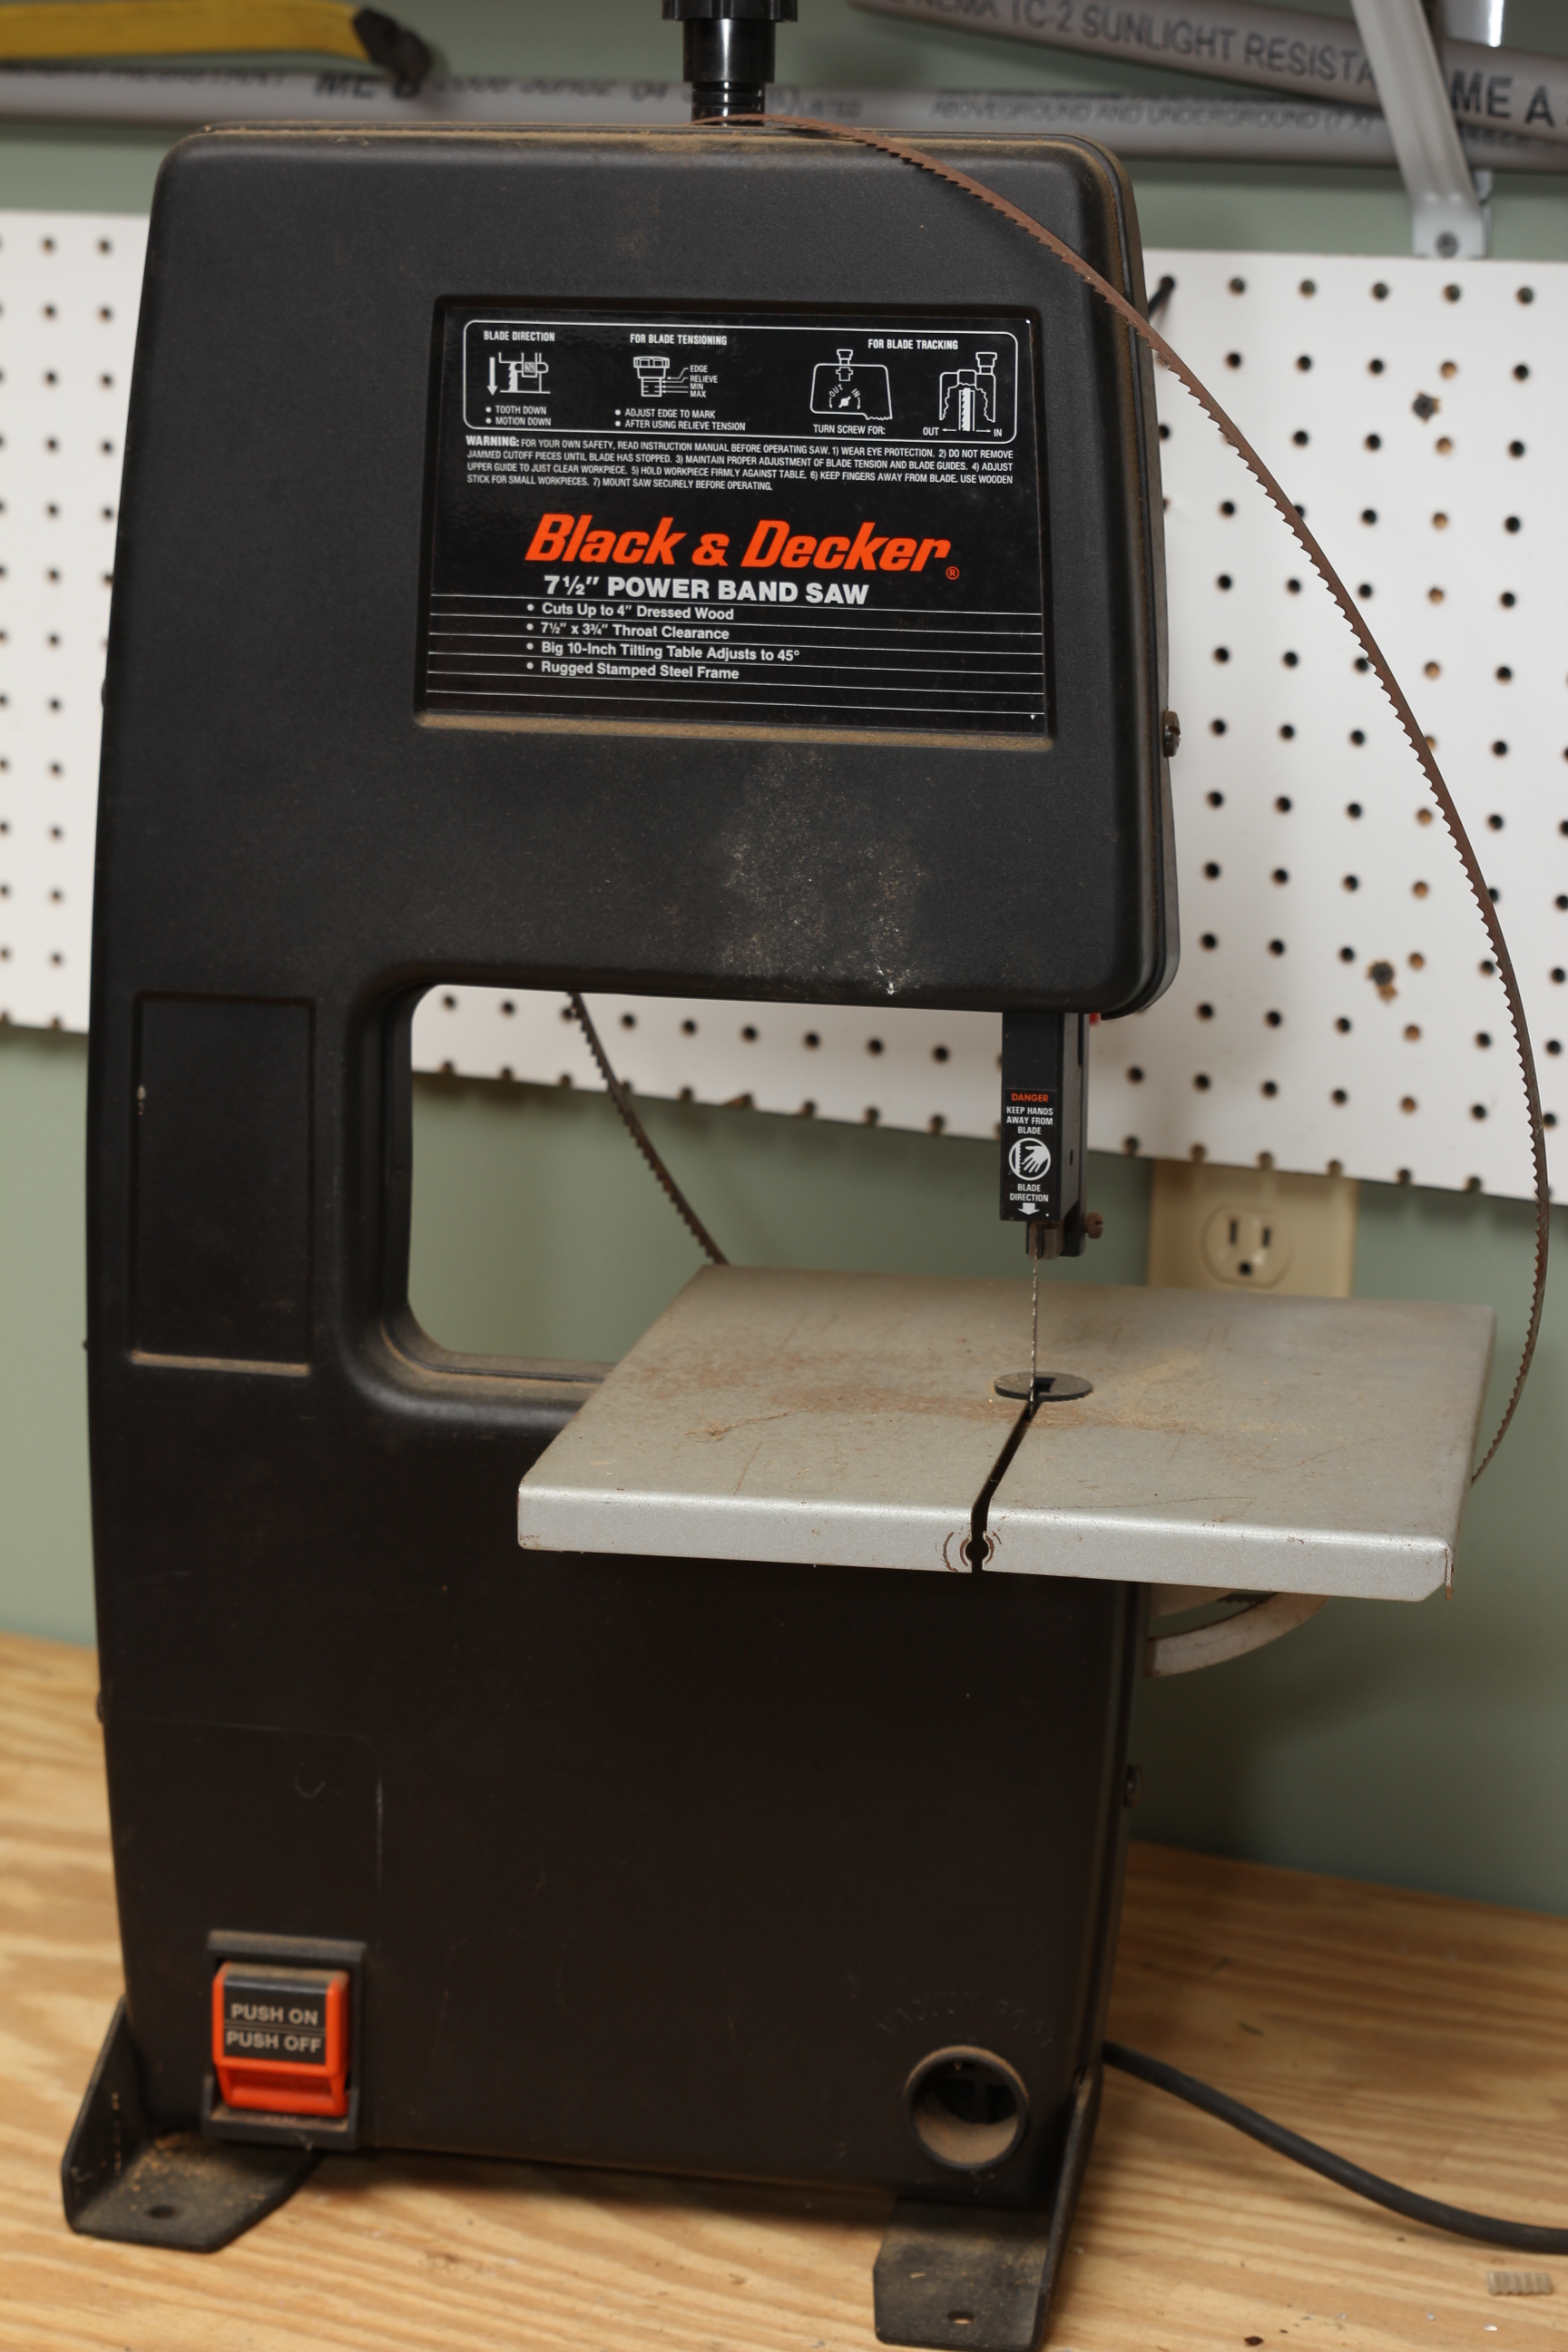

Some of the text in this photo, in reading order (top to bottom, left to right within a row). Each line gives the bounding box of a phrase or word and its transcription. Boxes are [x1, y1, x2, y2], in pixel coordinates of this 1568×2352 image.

[1081, 5, 1238, 60] SUNLIGHT
[1244, 32, 1378, 87] RESISTA
[1452, 71, 1513, 119] ME
[1524, 83, 1555, 128] A
[484, 330, 554, 341] BLADE DIRECTION
[630, 333, 727, 345] FOR BLADE TENSIONING
[868, 338, 957, 349] FOR BLADE TRACKING
[690, 375, 717, 383] RELIEVE
[828, 384, 842, 398] OUT
[848, 388, 860, 399] IN
[495, 405, 546, 414] TOOTH DOWN
[625, 407, 715, 418] ADJUST EDGE TO MARK
[495, 416, 551, 426] MOTION DOWN
[625, 419, 745, 430] AFTER USING RELIEVE TENSION
[813, 424, 885, 434] TURN SCREW FOR:
[923, 426, 939, 436] OUT
[994, 428, 1002, 436] IN
[466, 435, 1013, 458] WARNING: FOR YOUR OWN SAFETY, READ INSTRUCTION MANUAL BEFORE OPERATING SAW. 1) WEAR EYE PROTECTION. 2) DO NOT REMOVE
[467, 449, 1013, 472] JAMMED CUTOFF PIECES UNTIL BLADE HAS STOPPED. 3) MAINTAIN PROPER ADJUSTMENT OF BLADE TENSION AND BLADE GUIDES. 4) ADJUST
[467, 462, 1013, 484] UPPER GUIDE TO JUST CLEAR WORKPIECE. 5) HOLD WORKPIECE FIRMLY AGAINST TABLE. 6) KEEP FINGERS AWAY FROM BLADE. USE WOODEN
[467, 475, 772, 490] STICK FOR SMALL WORKPIECES. 7) MOUNT SAW SECURELY BEFORE OPERATING.
[524, 513, 687, 565] Black
[691, 533, 730, 567] &
[740, 519, 951, 572] Decker
[608, 577, 710, 599] POWER
[718, 580, 799, 603] BAND
[805, 583, 869, 605] SAW
[542, 602, 573, 615] Cuts
[577, 603, 596, 618] Up
[601, 604, 613, 616] to
[636, 605, 691, 619] Dressed
[694, 606, 734, 620] Wood
[571, 624, 579, 634] x
[612, 624, 658, 638] Throat
[662, 626, 730, 640] Clearance
[542, 642, 800, 662] Big 10-Inch Tilting Table Adjusts to 45°
[542, 661, 740, 680] Rugged Stamped Steel Frame
[1011, 1093, 1049, 1102] DANGER
[1006, 1106, 1054, 1115] KEEP HANDS
[1006, 1116, 1054, 1125] AWAY FROM
[1017, 1126, 1042, 1134] BLADE
[1017, 1183, 1041, 1192] BLADE
[1009, 1192, 1049, 1202] DIRECTION
[230, 2003, 318, 2025] PUSH ON
[226, 2030, 322, 2053] PUSH OFF
